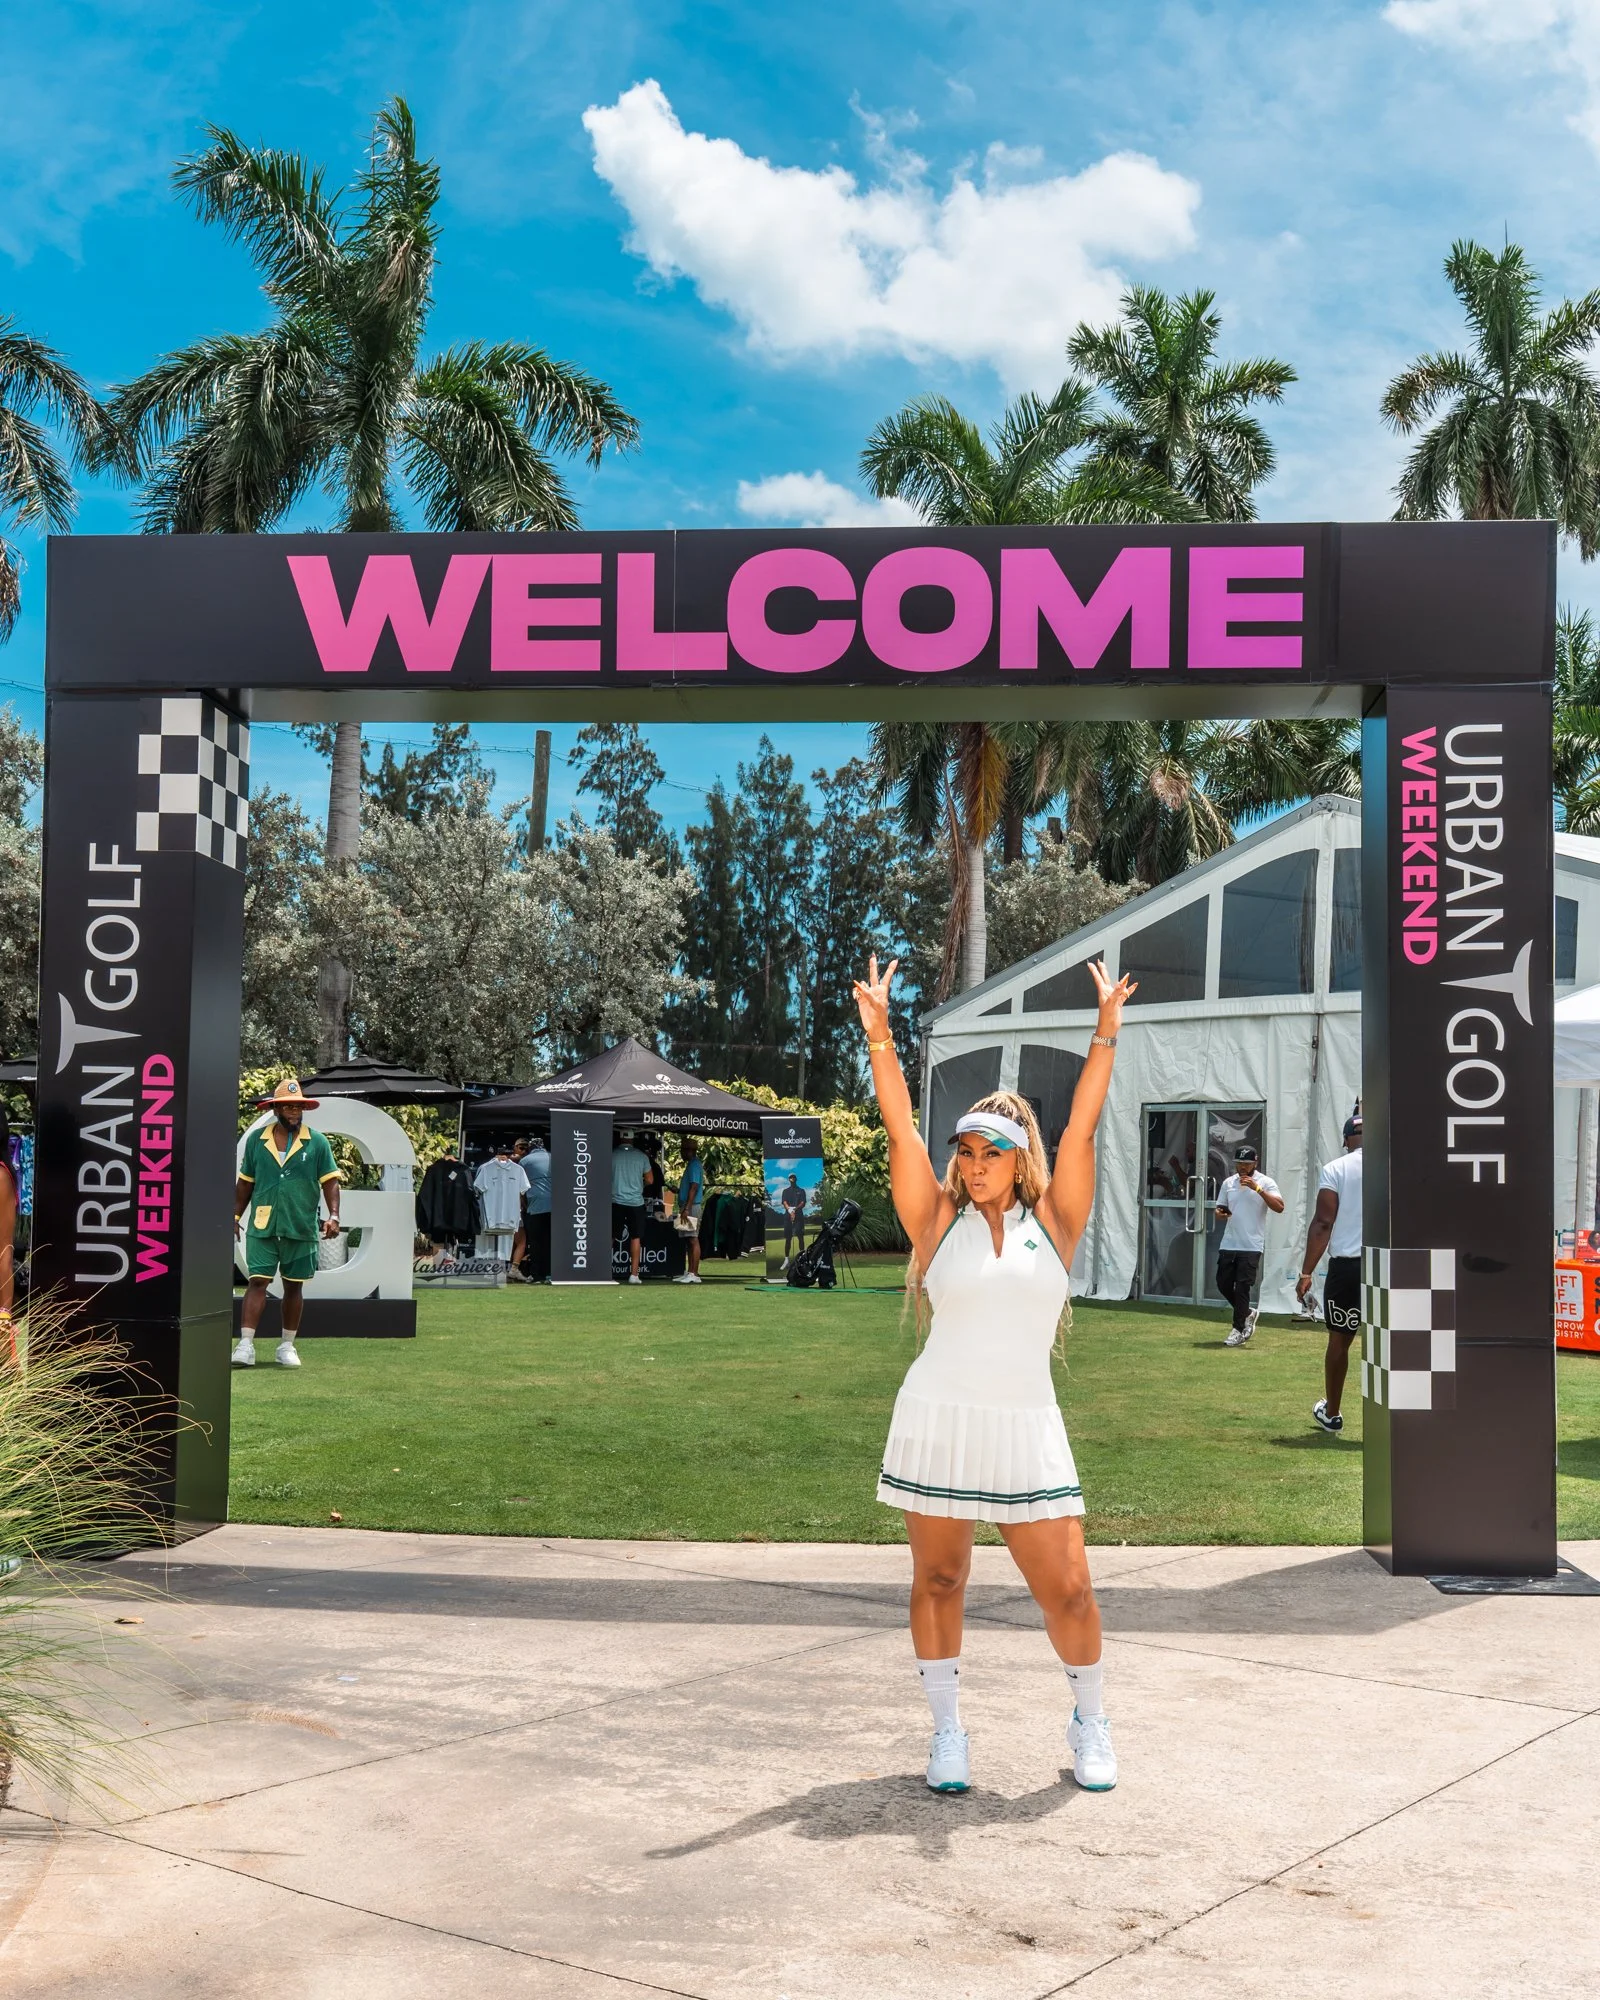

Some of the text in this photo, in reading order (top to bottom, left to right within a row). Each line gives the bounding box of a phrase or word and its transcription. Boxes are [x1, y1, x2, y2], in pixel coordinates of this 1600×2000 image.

[286, 545, 1304, 673] WELCOME
[1401, 726, 1438, 965] WEEKEND
[1444, 723, 1505, 1184] URBAN GOLF
[75, 842, 142, 1283] URBAN GOLF
[632, 1083, 710, 1094] blackballed
[643, 1112, 748, 1130] blackballedgolf.com
[135, 1053, 175, 1283] WEEKEND
[573, 1130, 591, 1268] blackballedgolf
[612, 1247, 667, 1263] kblled
[612, 1265, 650, 1273] Your ark.
[1556, 1275, 1577, 1288] IFT
[1555, 1302, 1577, 1315] IFE
[1556, 1329, 1584, 1339] GISTRY
[1557, 1321, 1584, 1331] RROW
